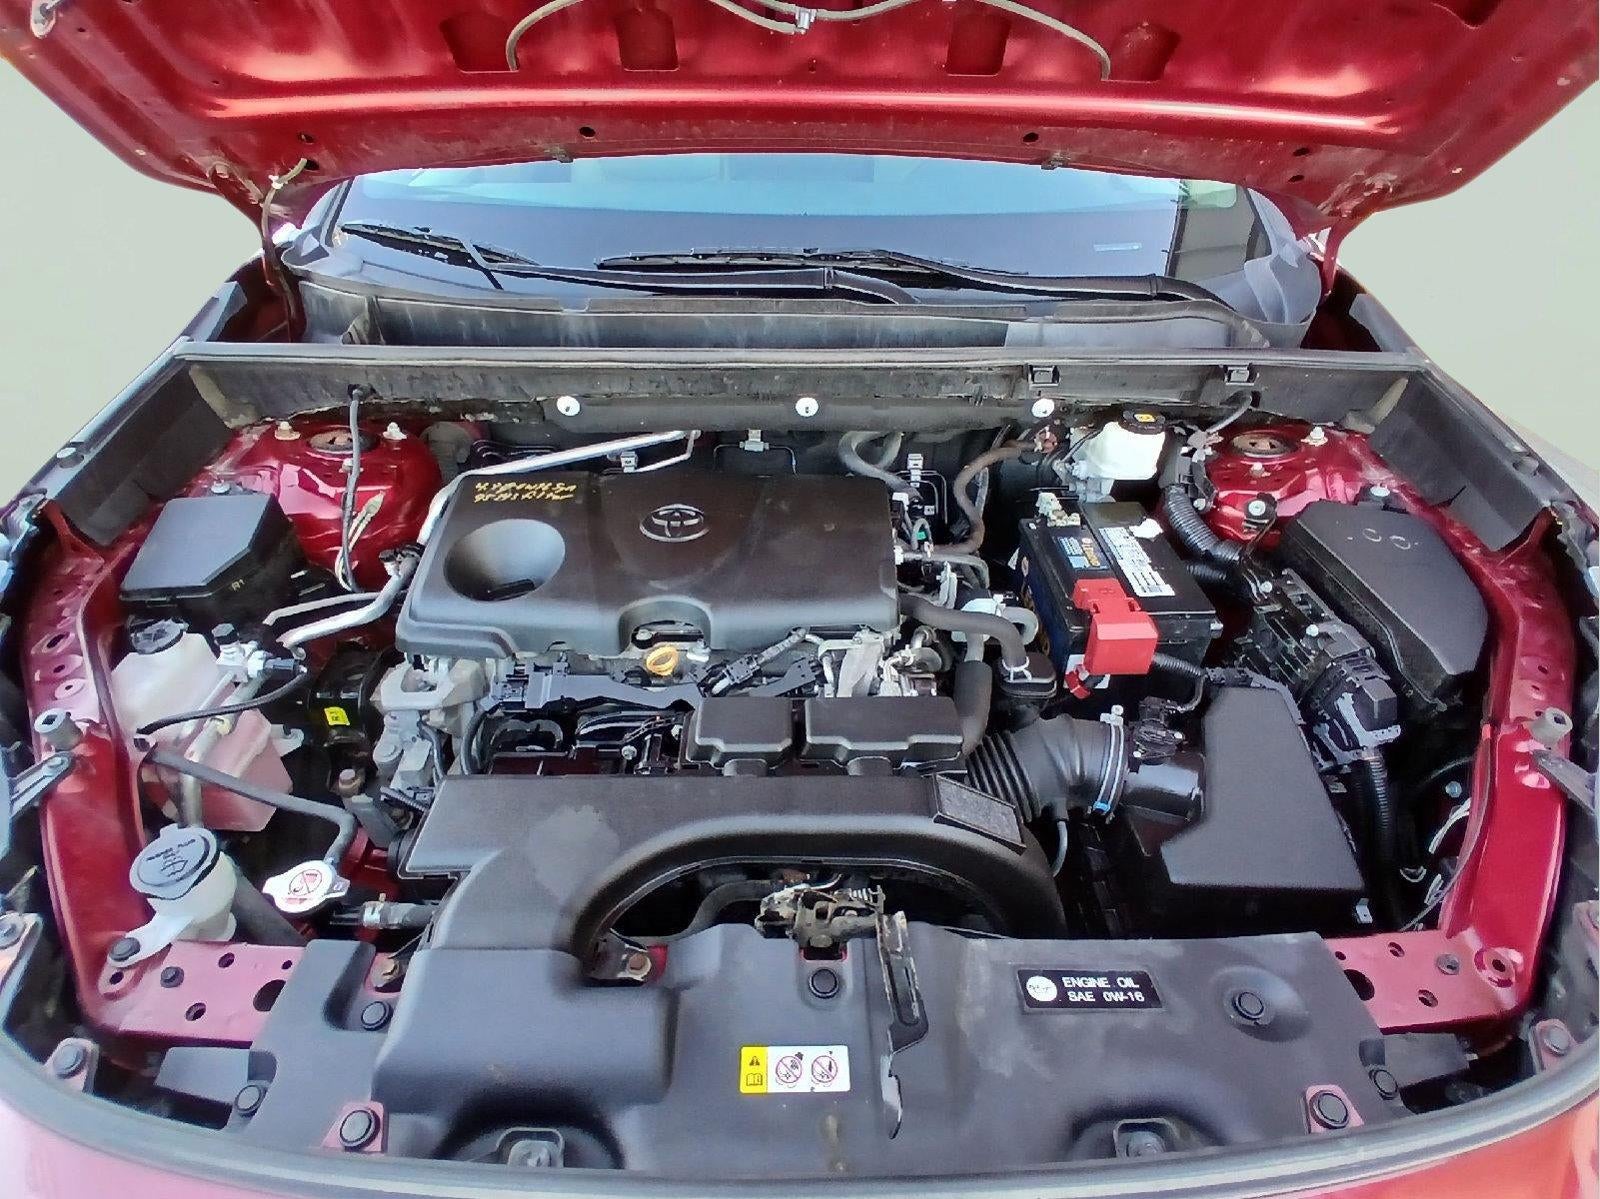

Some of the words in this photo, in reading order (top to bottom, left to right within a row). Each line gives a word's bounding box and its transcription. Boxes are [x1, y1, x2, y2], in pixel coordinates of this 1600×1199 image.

[1062, 976, 1111, 988] ENGINE
[1116, 976, 1140, 988] OIL
[1067, 991, 1096, 1002] SAE
